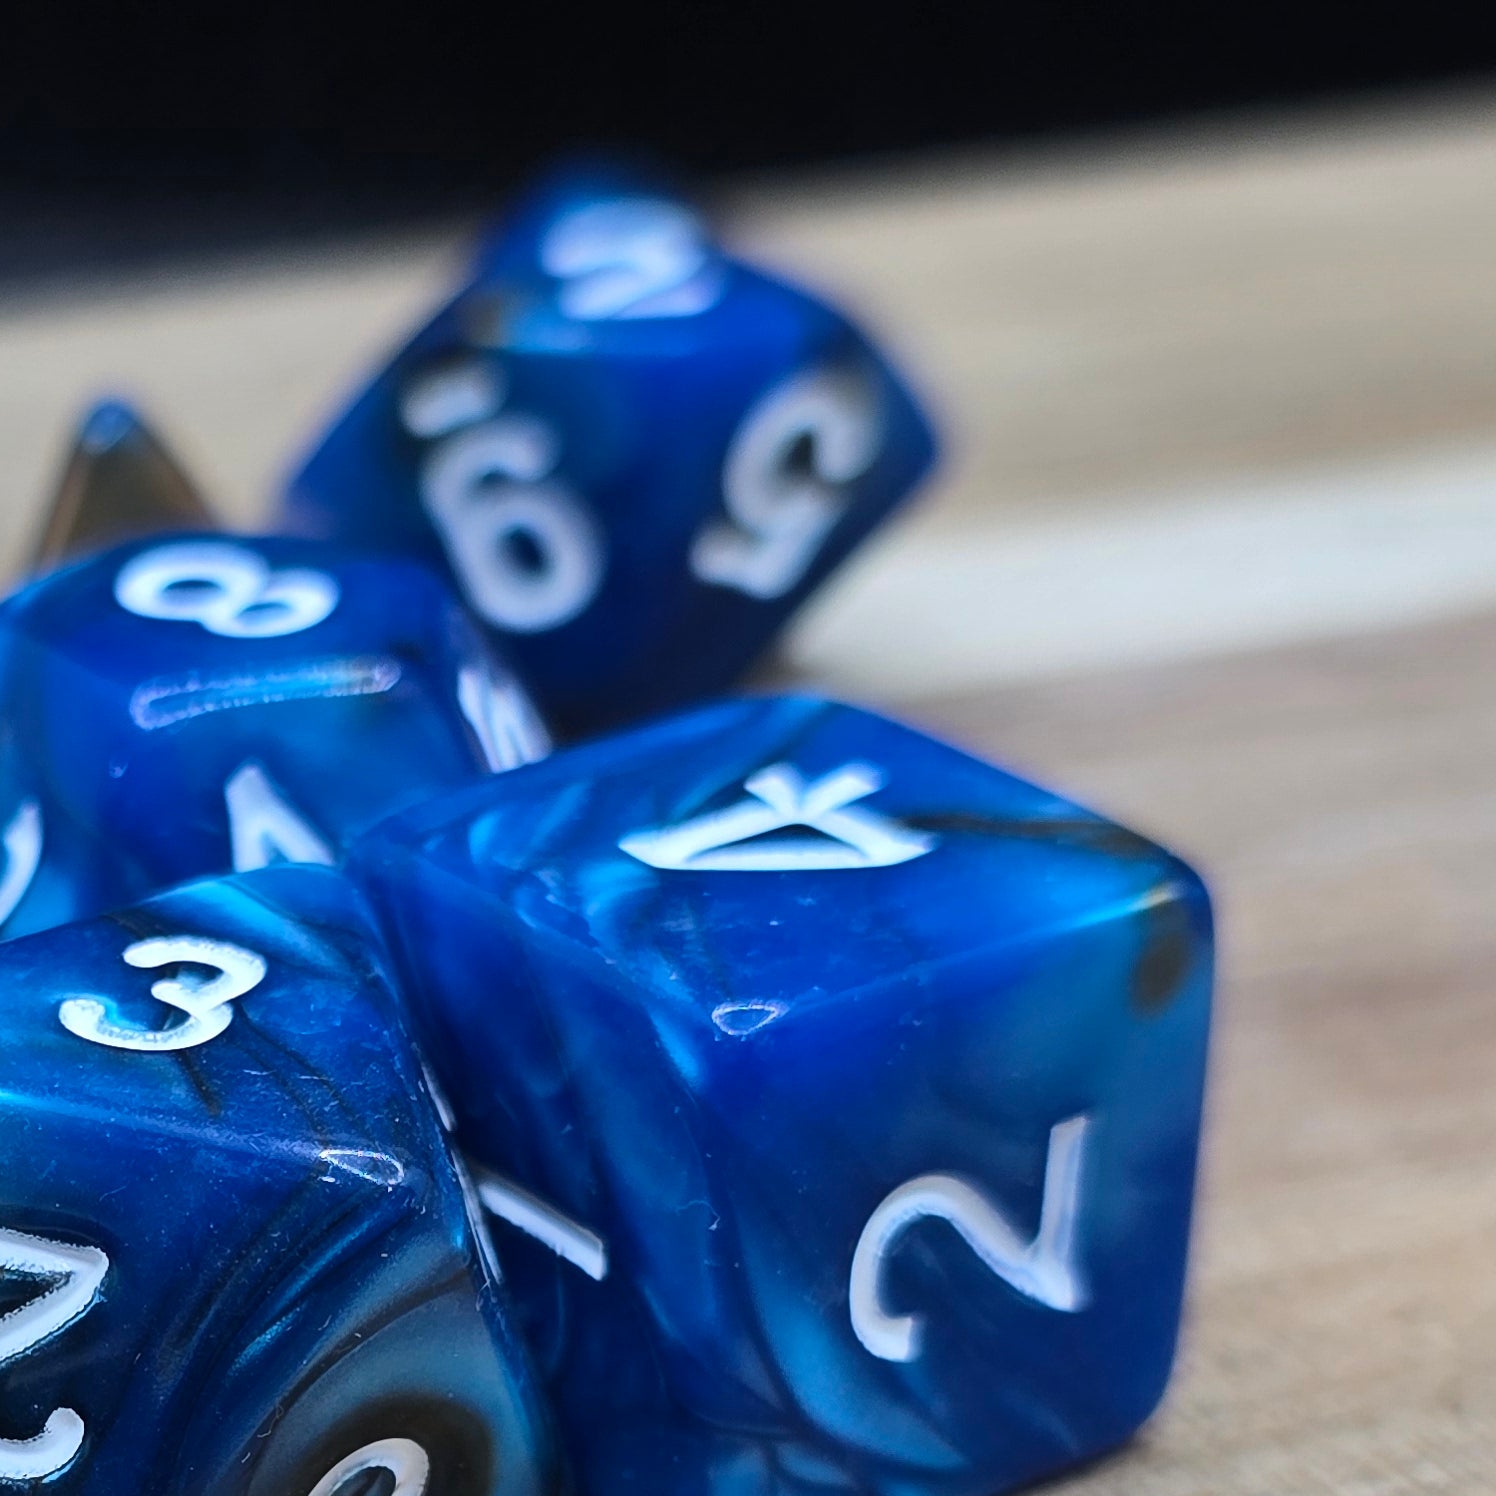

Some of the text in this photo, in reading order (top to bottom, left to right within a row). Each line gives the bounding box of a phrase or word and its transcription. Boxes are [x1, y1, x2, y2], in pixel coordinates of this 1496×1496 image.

[115, 542, 338, 639] 8
[617, 764, 936, 872] 4
[59, 936, 268, 1051] 3
[848, 1114, 1091, 1362] 2
